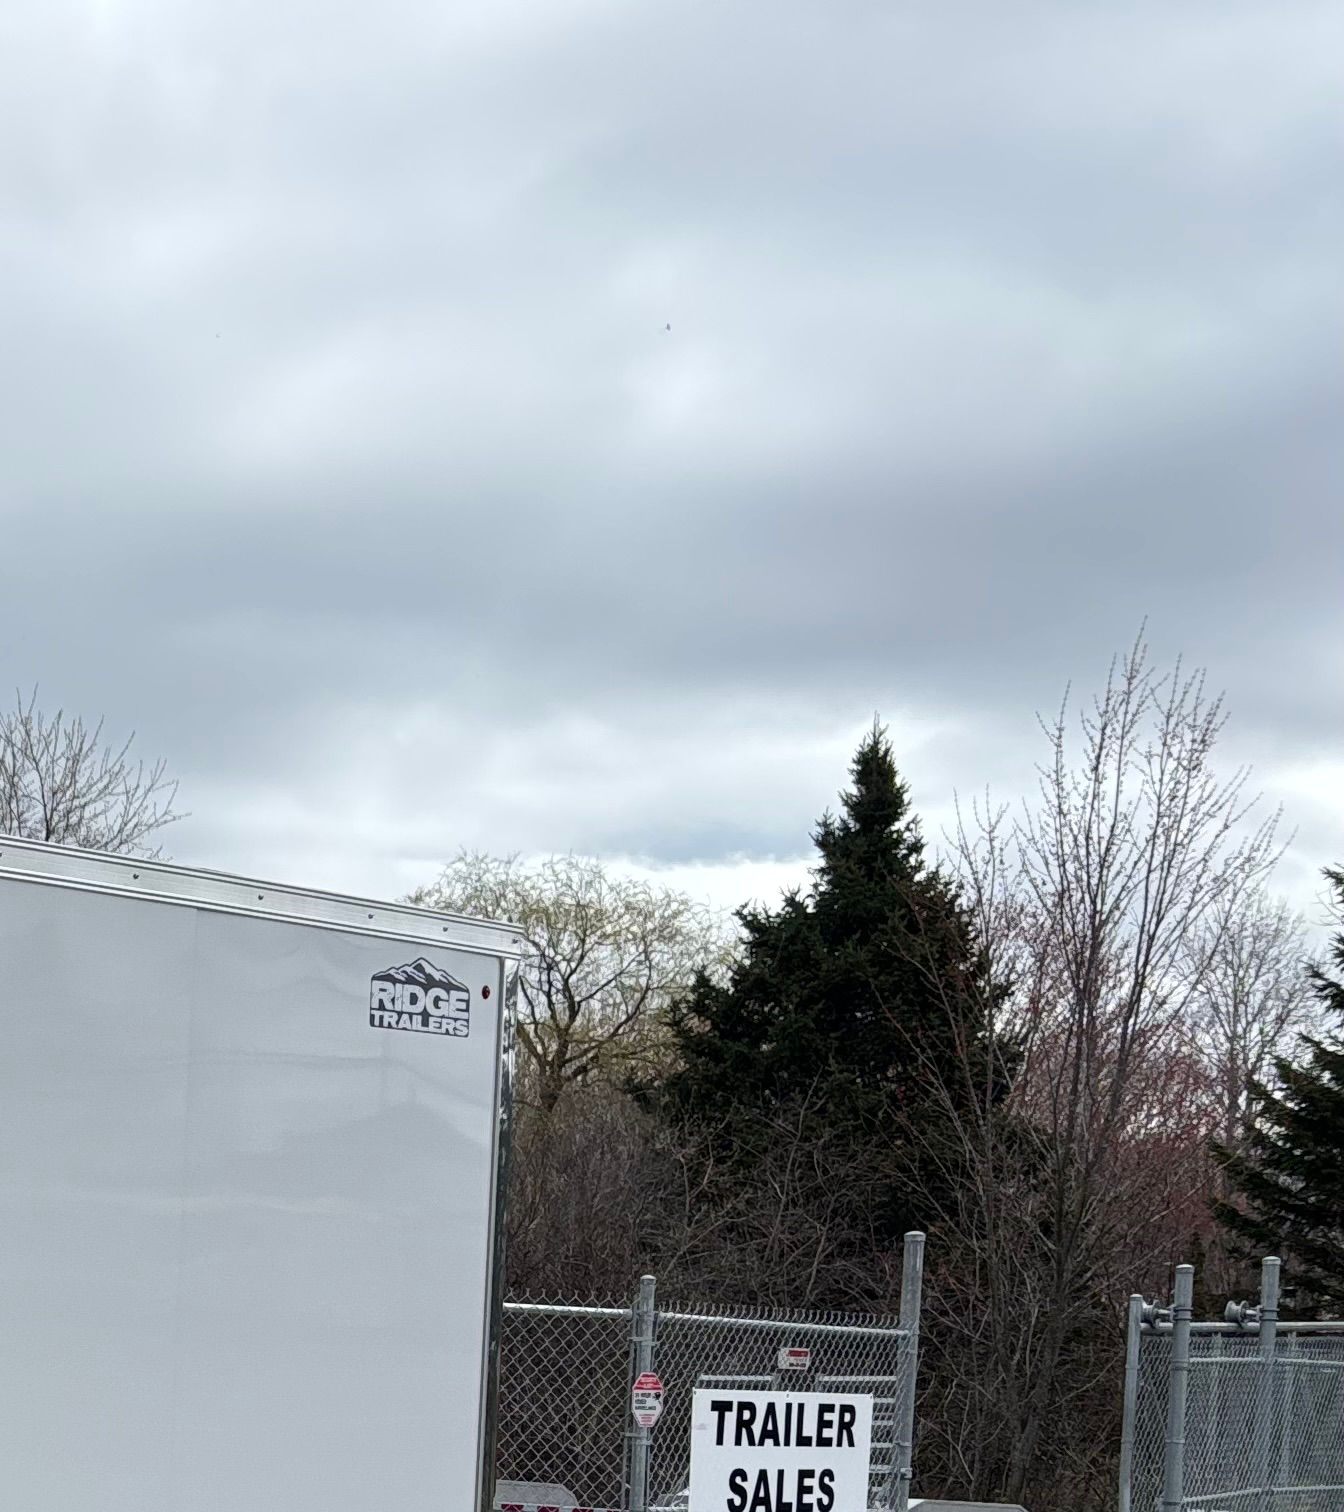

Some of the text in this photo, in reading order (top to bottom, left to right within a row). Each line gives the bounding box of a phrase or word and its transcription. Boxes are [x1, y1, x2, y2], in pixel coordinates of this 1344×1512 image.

[371, 980, 469, 1019] RIDGE
[370, 1010, 469, 1036] TRAILERS
[710, 1400, 856, 1447] TRAILER
